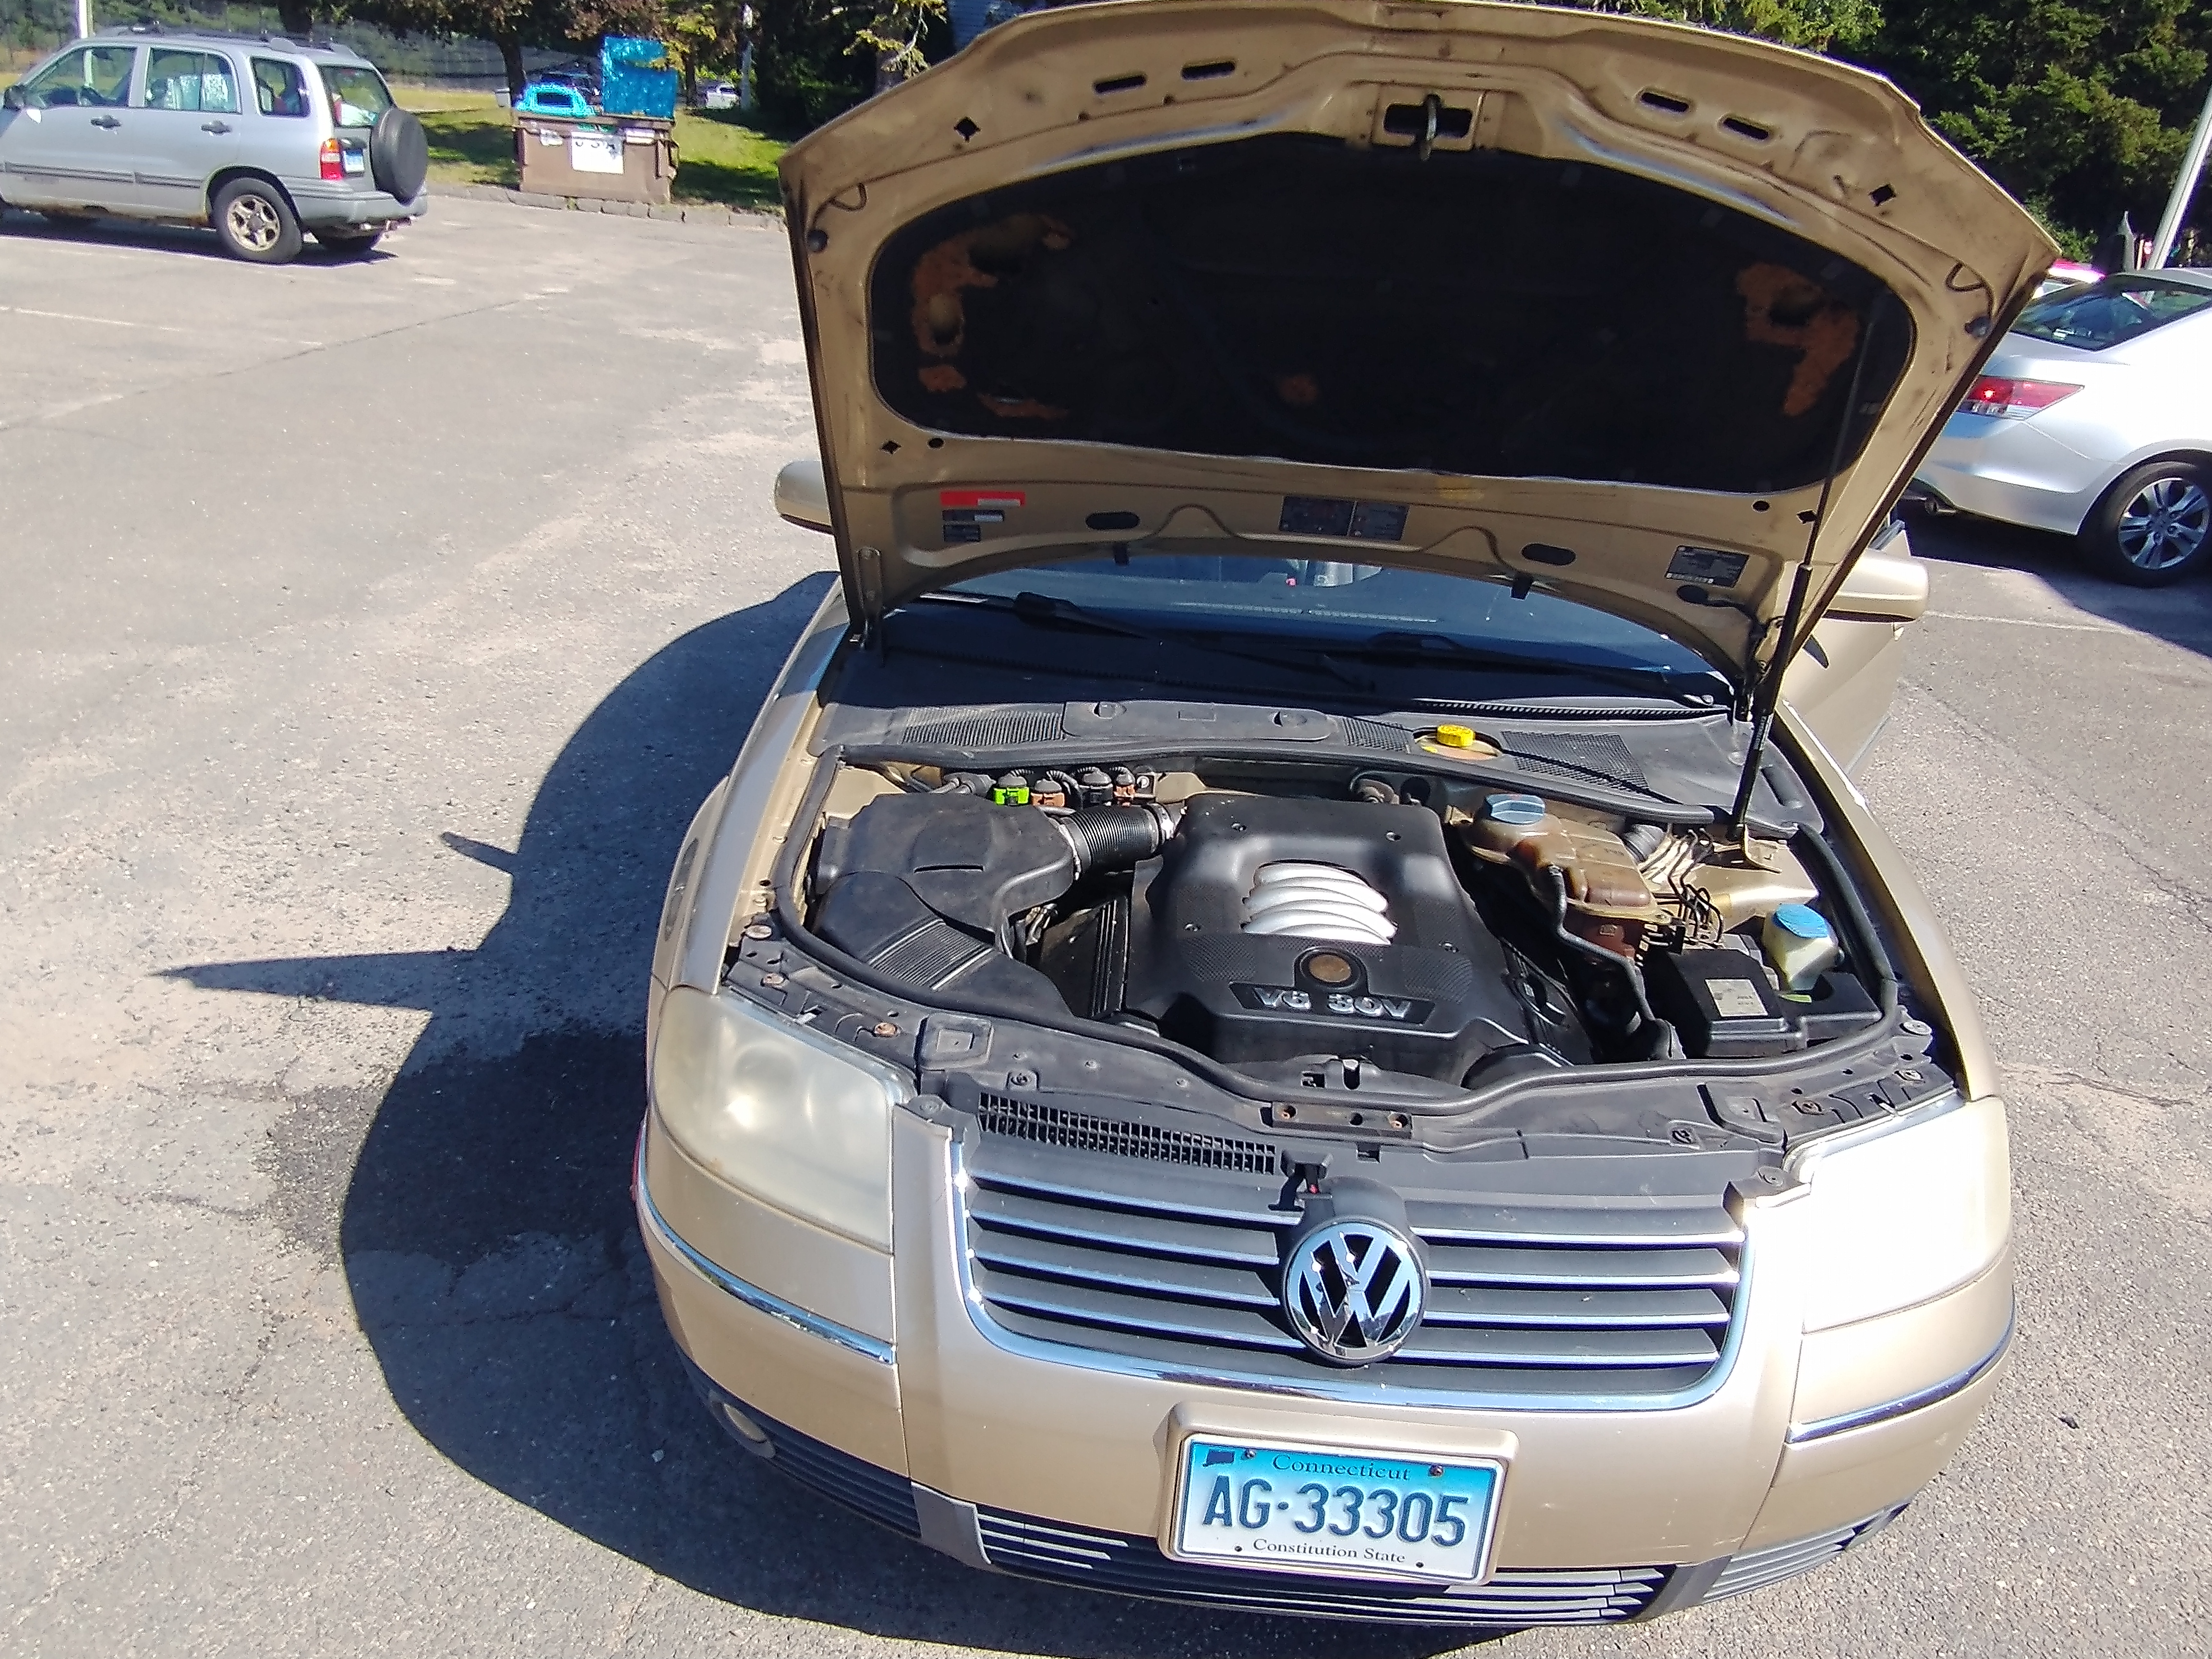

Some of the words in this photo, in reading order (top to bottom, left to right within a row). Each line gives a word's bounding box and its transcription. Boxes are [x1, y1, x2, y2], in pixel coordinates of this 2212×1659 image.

[1272, 1454, 1411, 1481] Connecticut
[1253, 1538, 1358, 1559] Constitution
[1363, 1547, 1407, 1564] State
